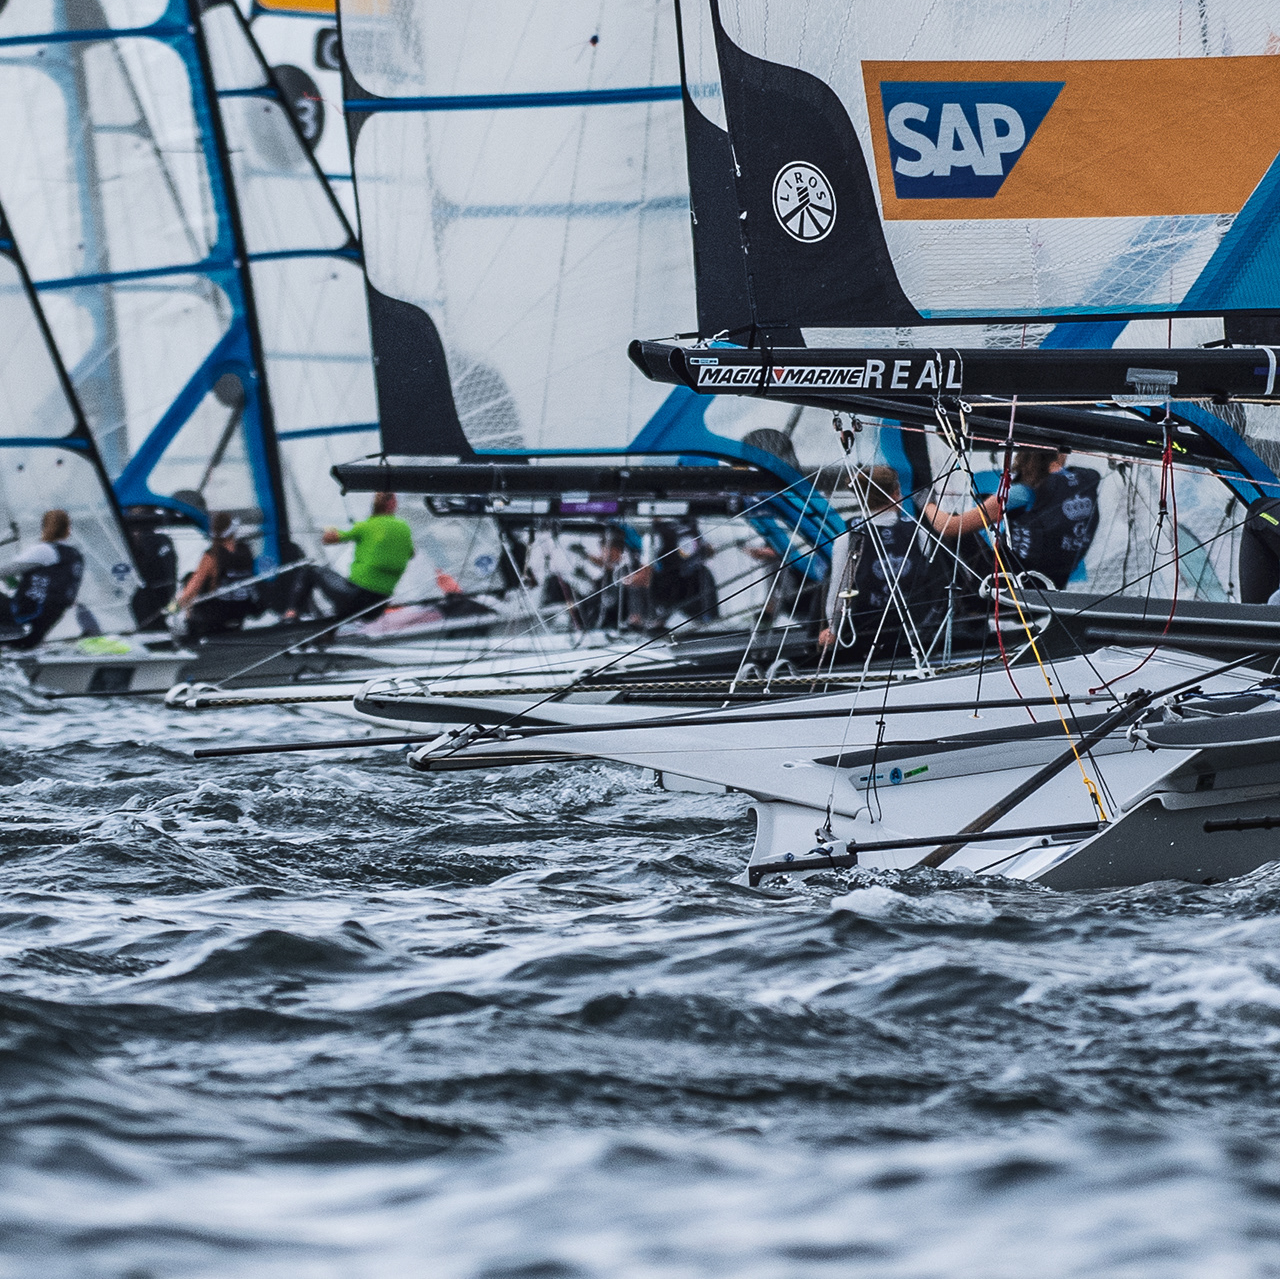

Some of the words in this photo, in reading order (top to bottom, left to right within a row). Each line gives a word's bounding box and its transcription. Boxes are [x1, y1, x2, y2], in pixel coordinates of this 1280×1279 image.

[888, 102, 1026, 178] SAP
[780, 171, 826, 202] LIROS
[700, 367, 766, 385] MAGIC
[781, 368, 865, 385] MARINE
[864, 359, 962, 389] REAL
